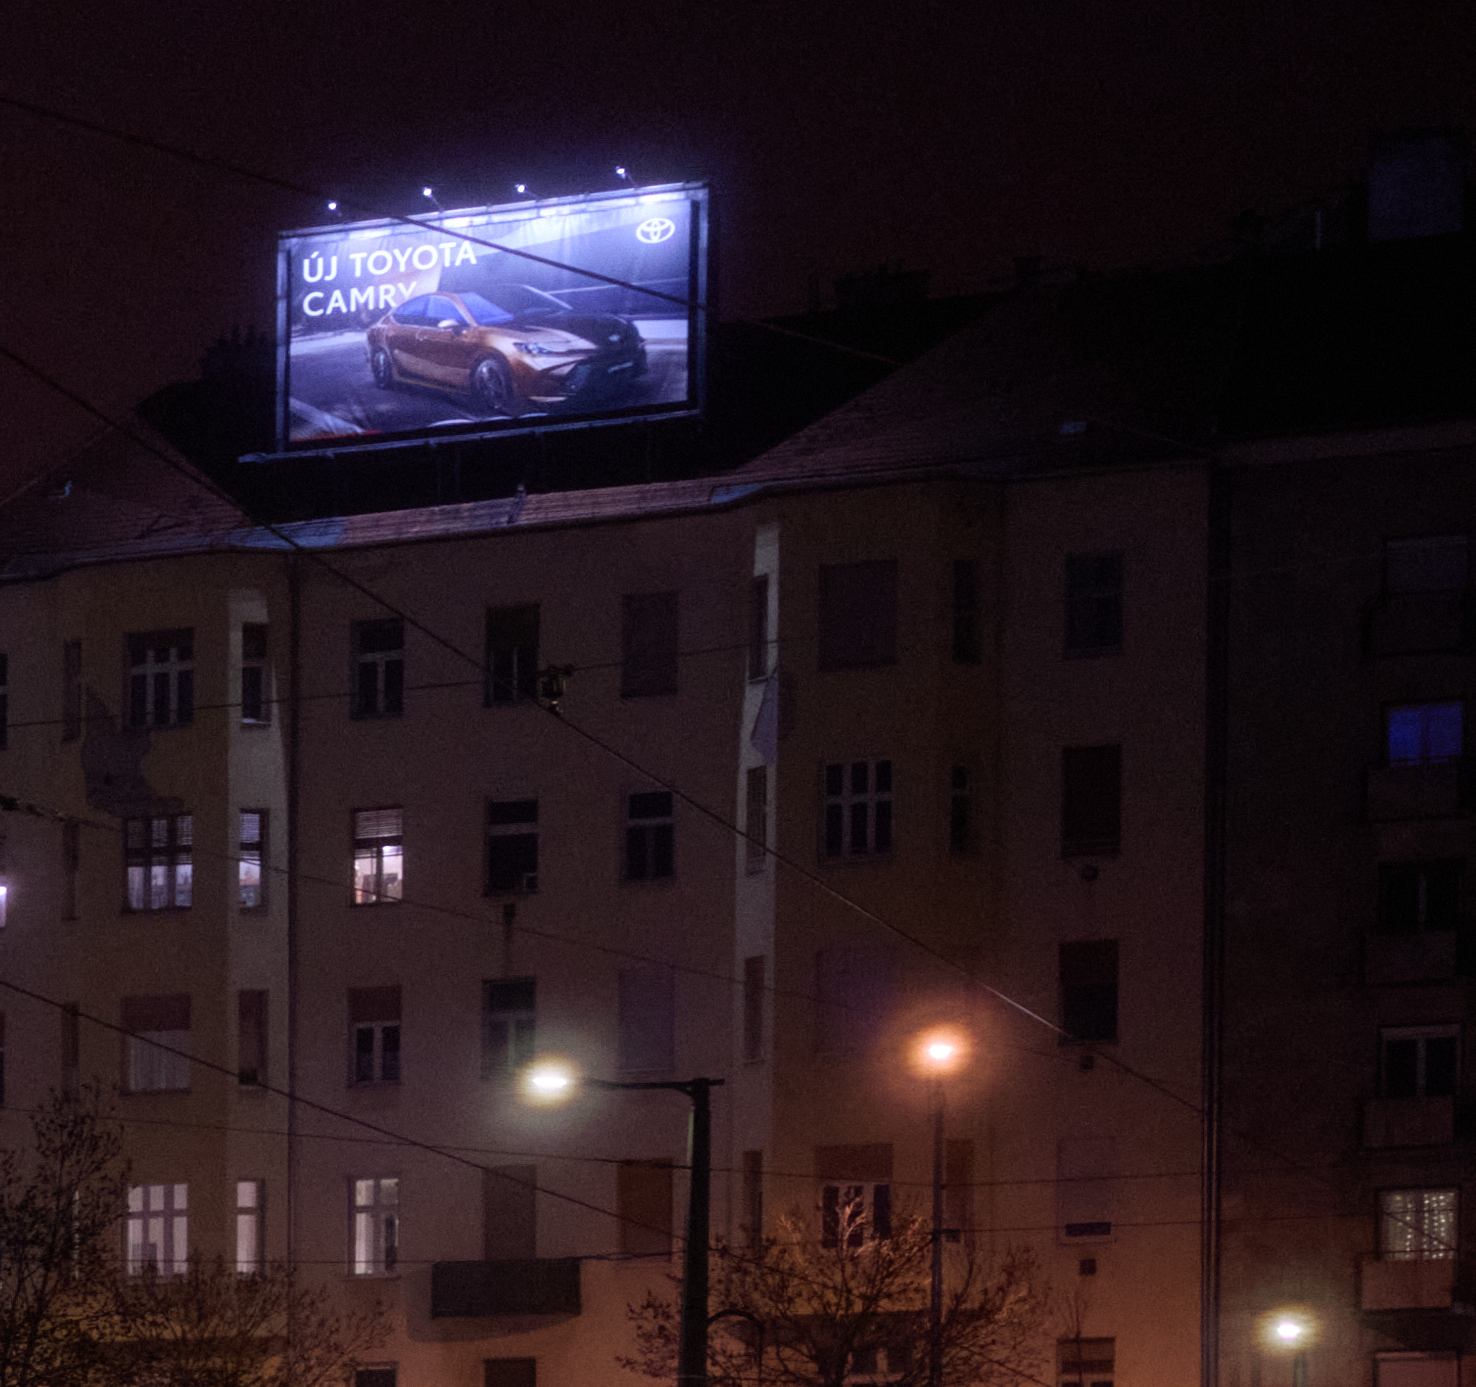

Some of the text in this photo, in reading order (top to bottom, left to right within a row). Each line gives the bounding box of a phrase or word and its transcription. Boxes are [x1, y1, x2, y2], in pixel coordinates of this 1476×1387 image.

[302, 240, 477, 283] ÚJ TOYOTA
[302, 281, 417, 317] CAMRY
